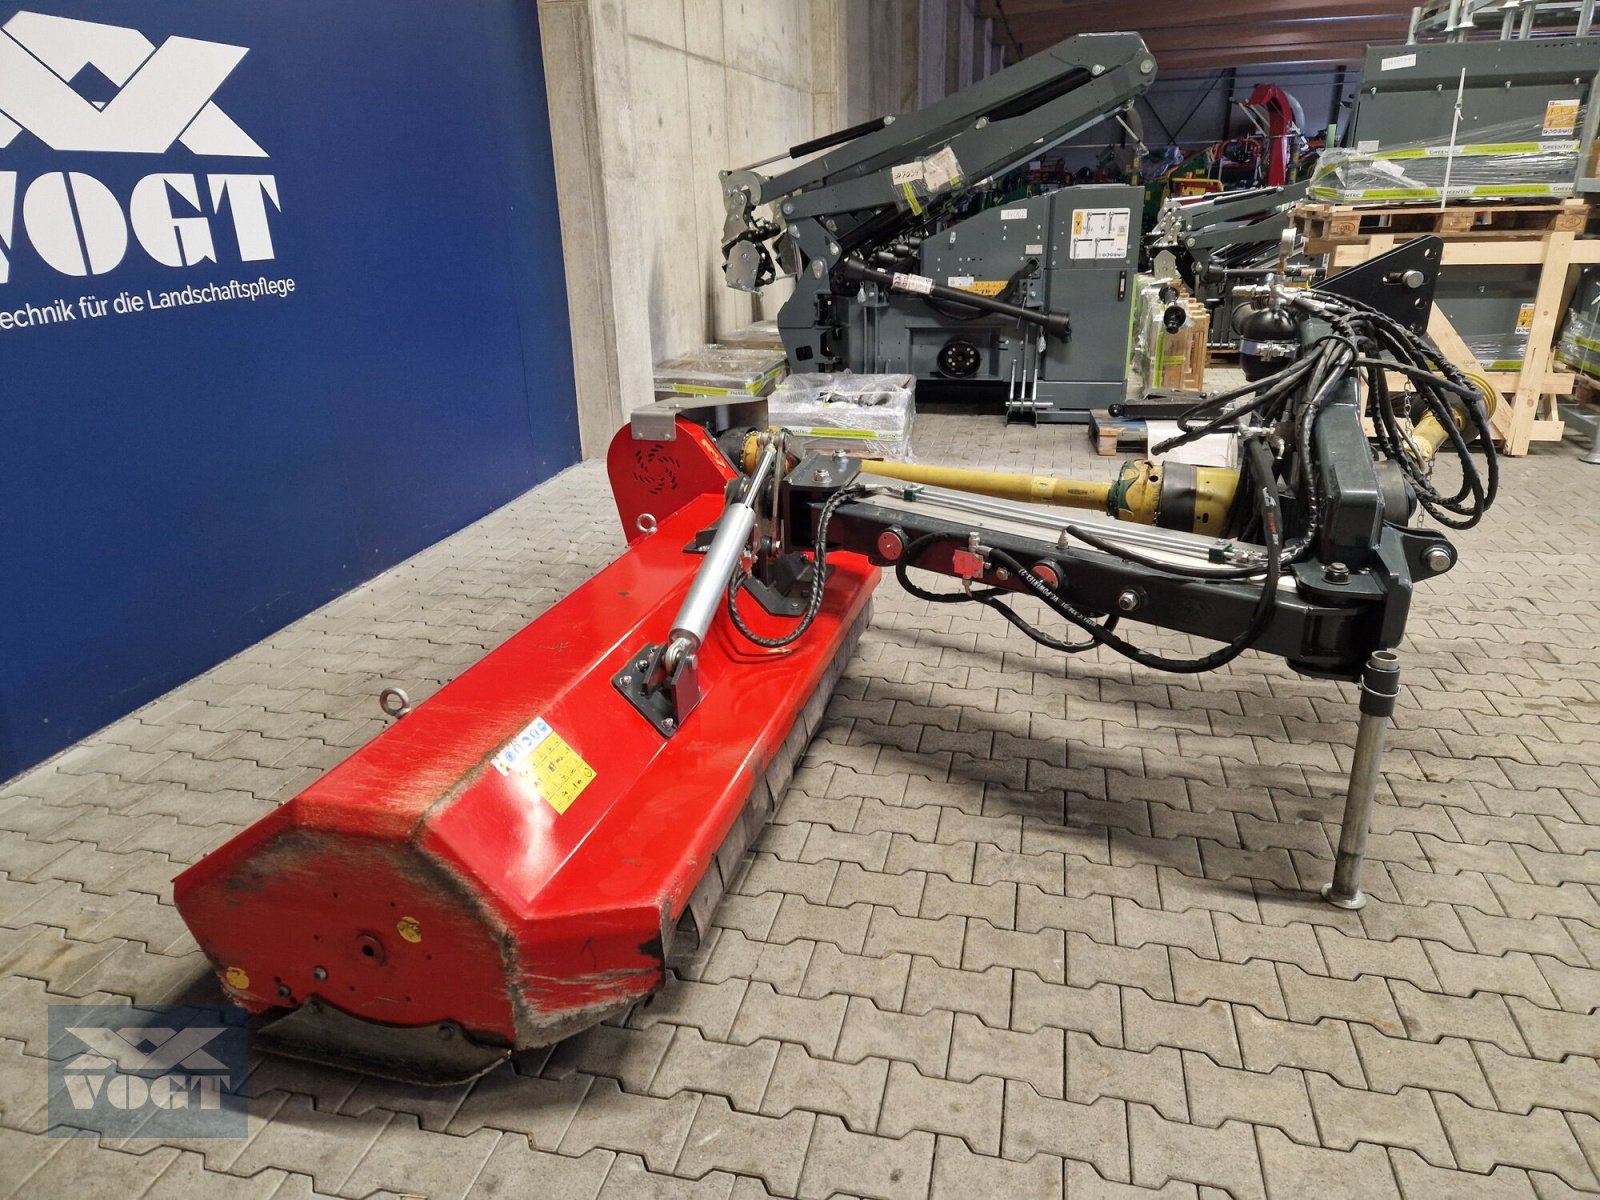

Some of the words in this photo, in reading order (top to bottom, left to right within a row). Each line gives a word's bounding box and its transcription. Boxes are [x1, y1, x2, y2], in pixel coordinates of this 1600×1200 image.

[0, 171, 281, 283] OGT
[78, 295, 108, 318] für
[113, 291, 145, 314] die
[146, 276, 296, 310] Landschaftspflege
